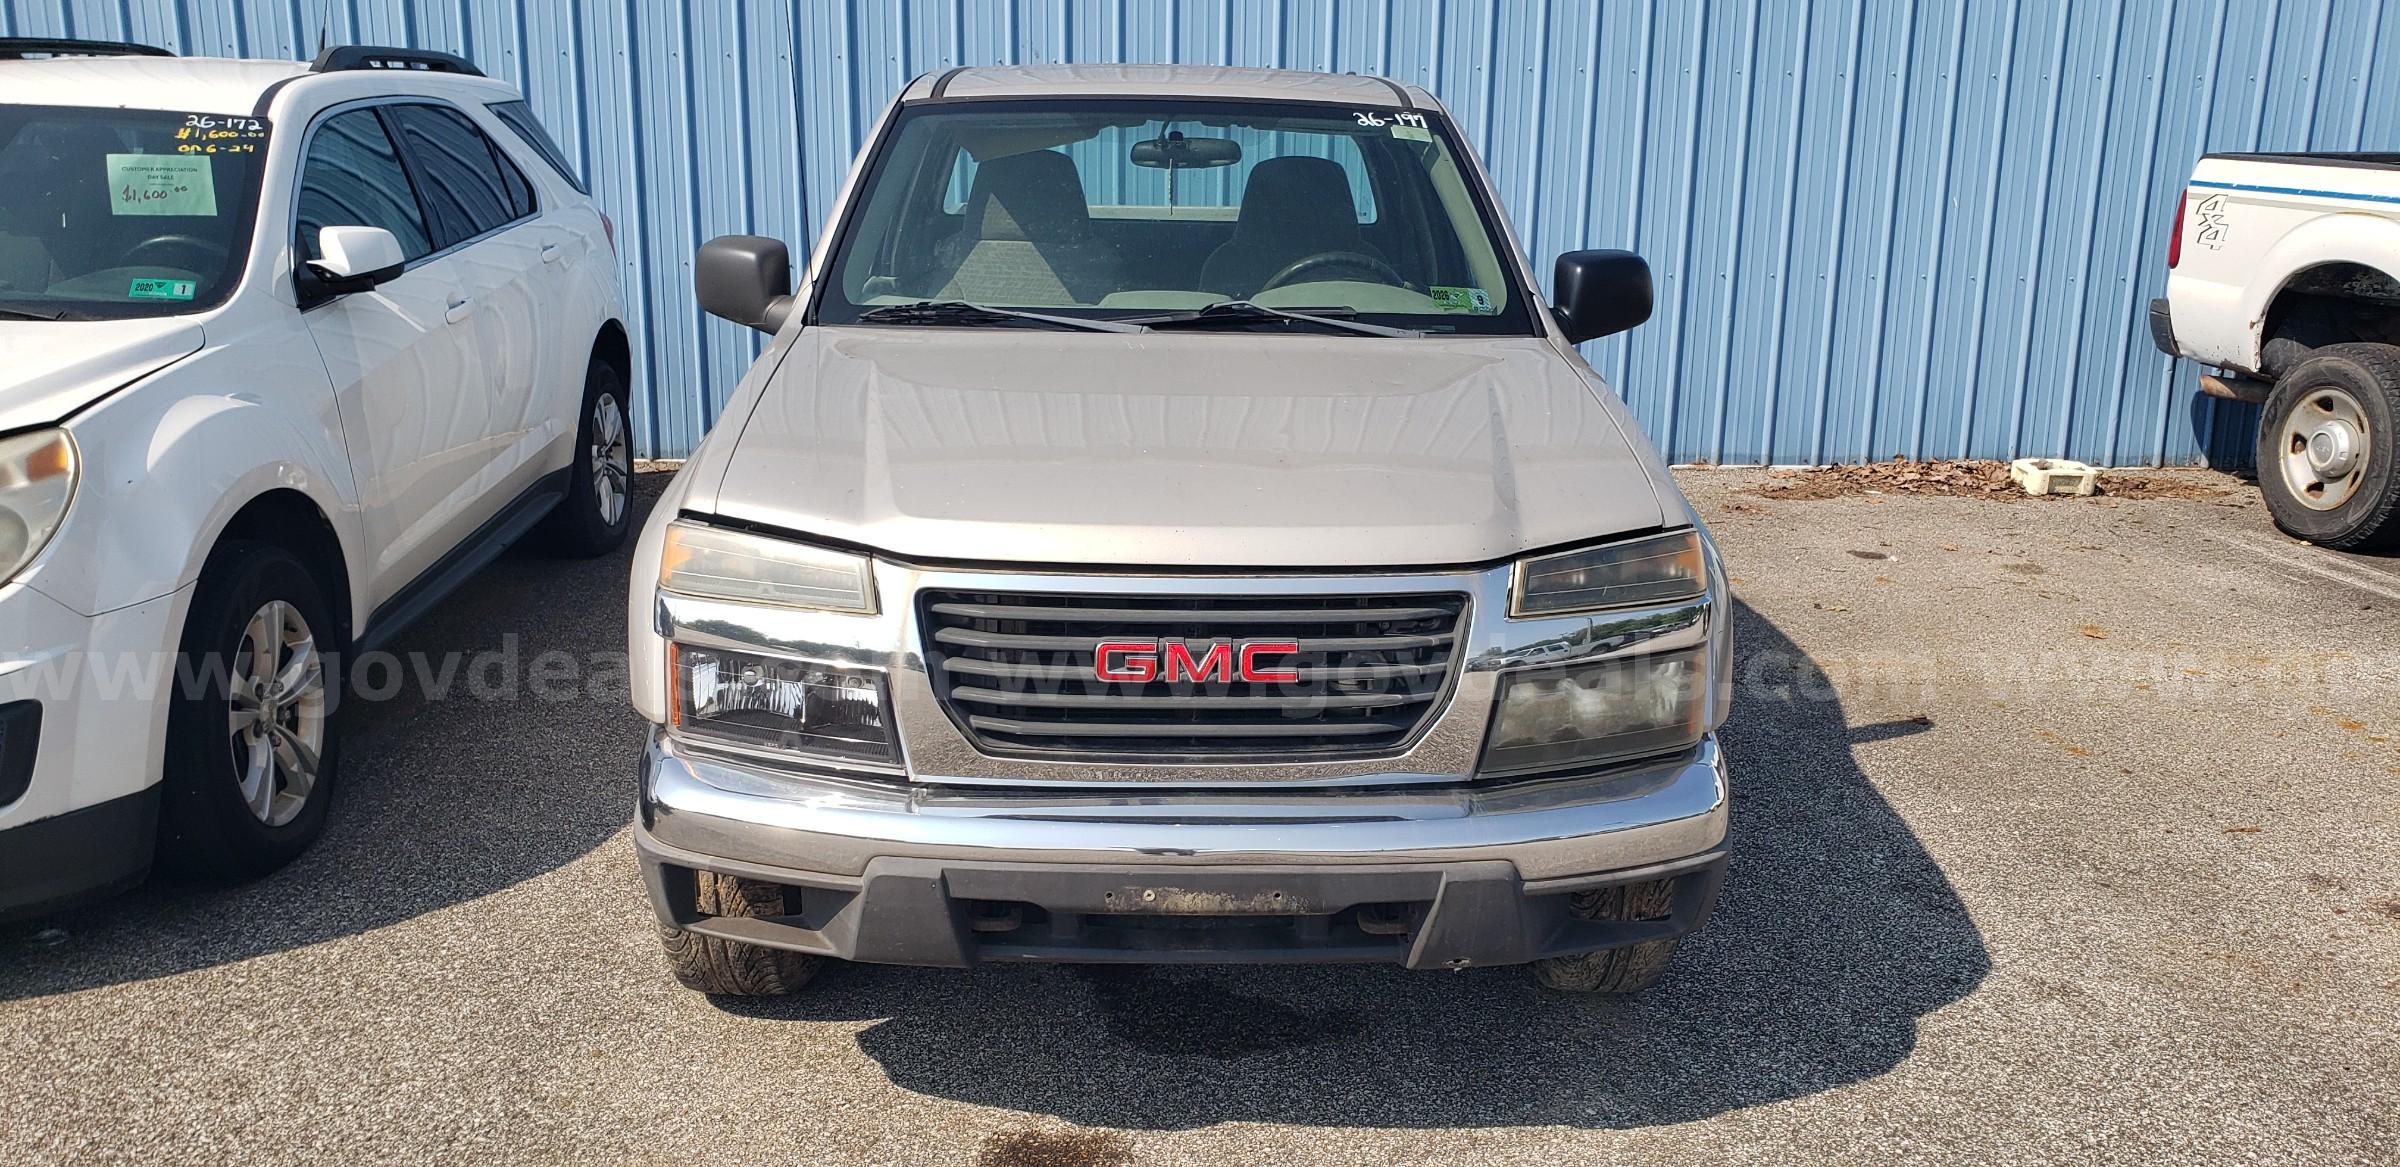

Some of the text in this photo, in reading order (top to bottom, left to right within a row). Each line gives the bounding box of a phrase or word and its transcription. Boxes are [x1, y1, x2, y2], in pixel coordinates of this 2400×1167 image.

[186, 115, 263, 130] 26-172
[1353, 112, 1428, 129] 26-197
[135, 283, 186, 294] 2020 1
[1477, 295, 1484, 305] 9
[1095, 642, 1298, 683] GMC
